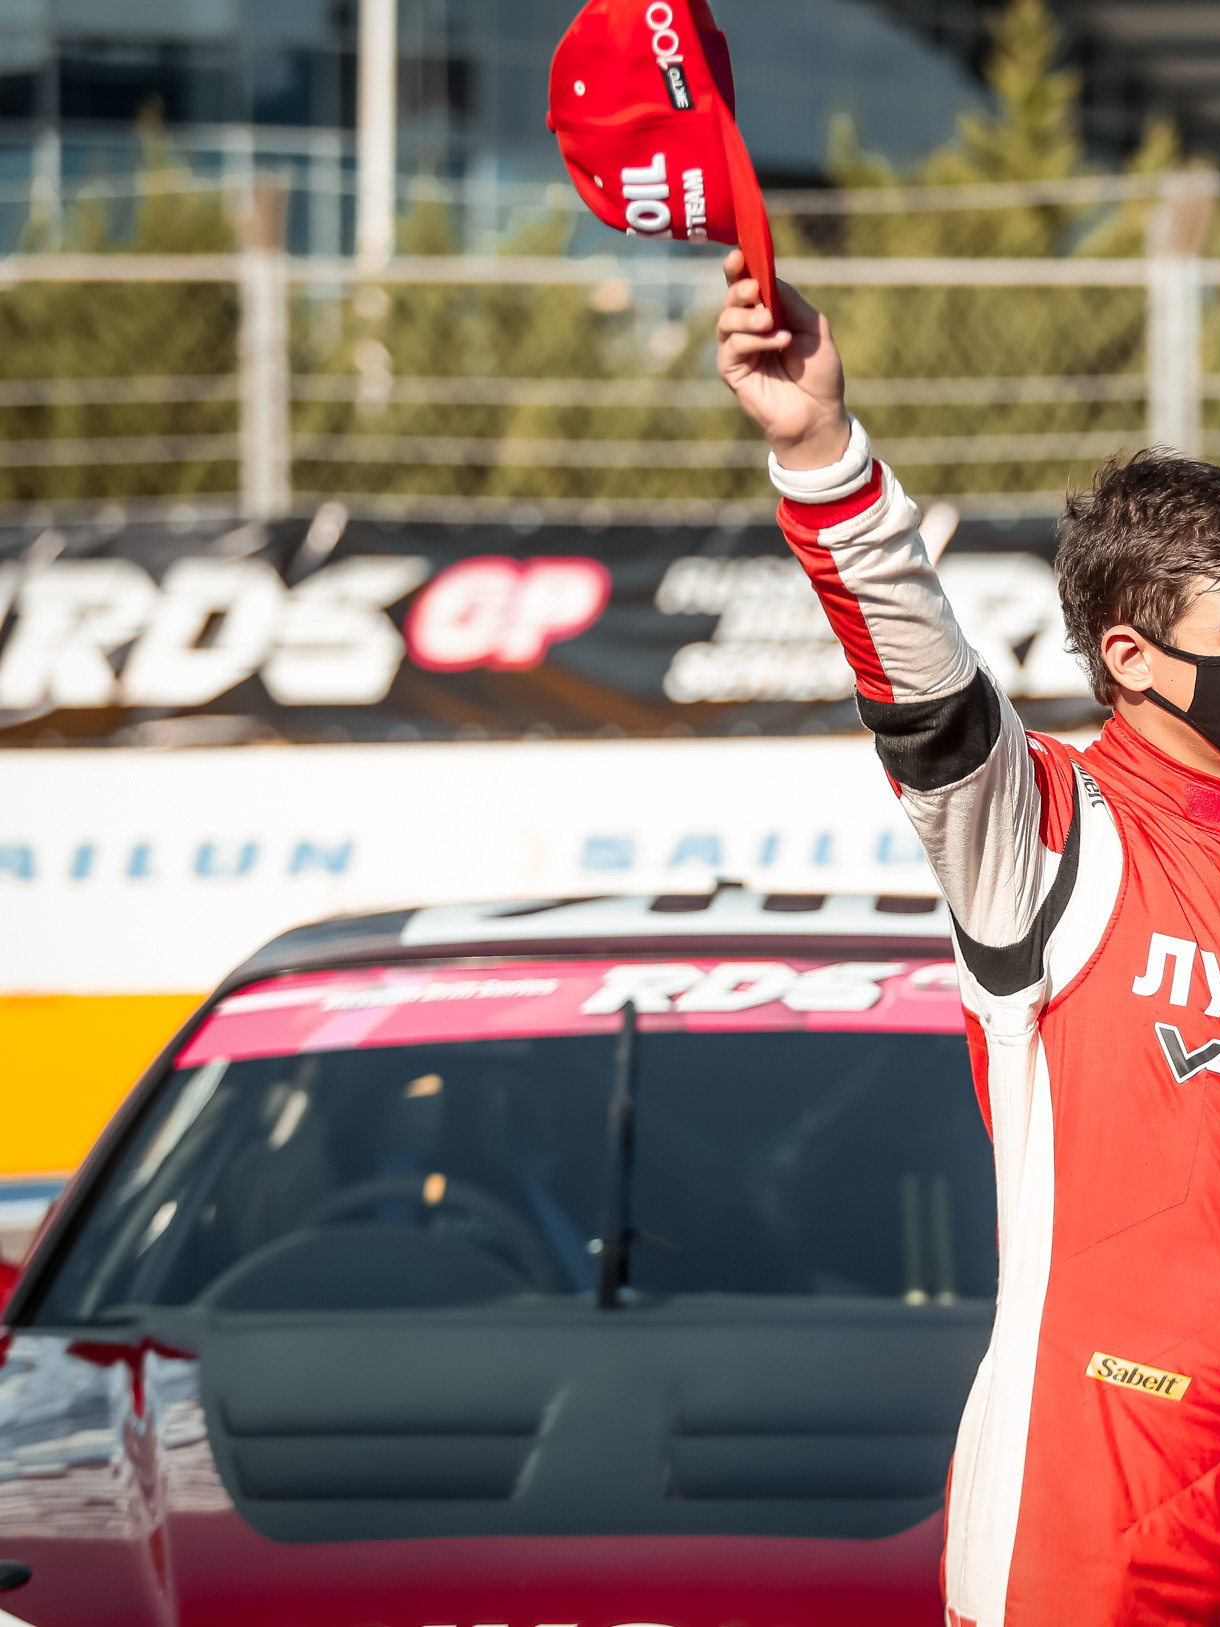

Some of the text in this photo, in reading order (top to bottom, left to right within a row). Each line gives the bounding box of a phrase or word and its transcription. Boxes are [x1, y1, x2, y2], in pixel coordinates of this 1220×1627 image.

[646, 1, 684, 70] 100
[621, 152, 673, 240] OIL
[682, 168, 707, 228] TEAM
[0, 557, 430, 707] RDS
[406, 556, 611, 672] GP
[0, 842, 356, 881] AILUN
[581, 961, 908, 1014] RDS
[1097, 1357, 1178, 1395] Sabelt
